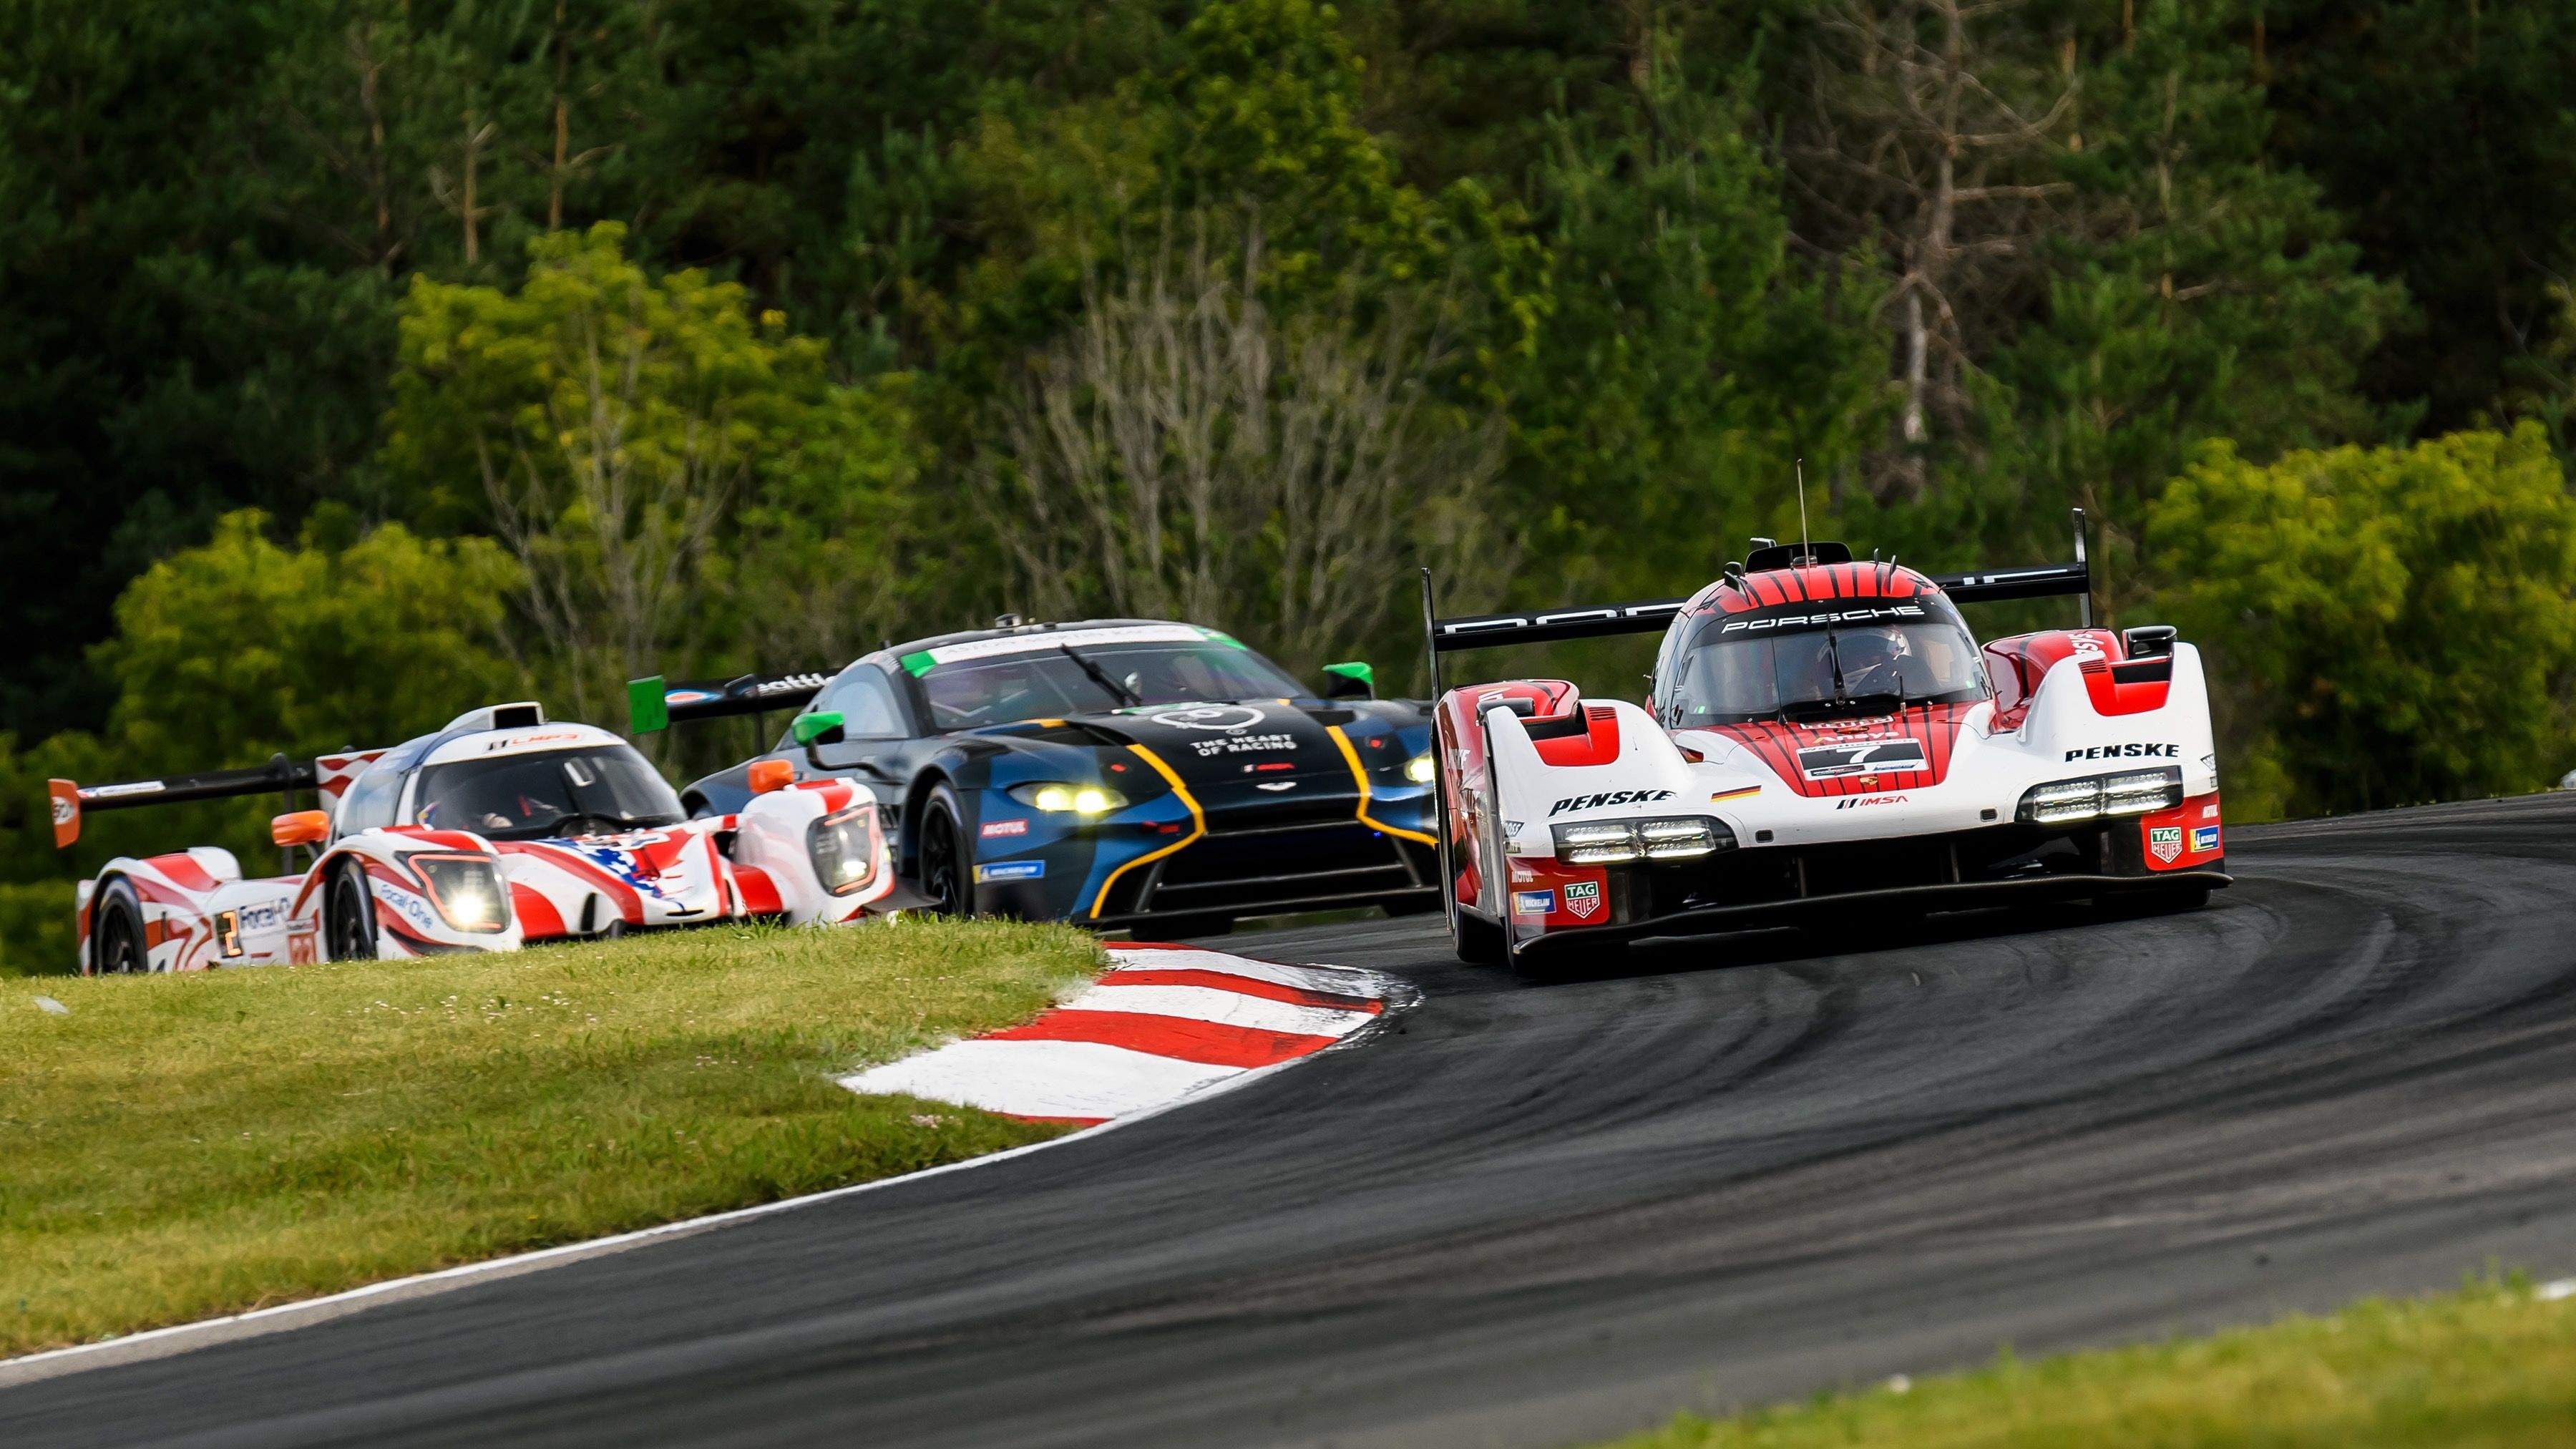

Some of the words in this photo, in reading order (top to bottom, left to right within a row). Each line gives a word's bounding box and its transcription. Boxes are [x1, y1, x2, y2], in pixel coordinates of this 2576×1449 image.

[1721, 605, 1925, 634] PORSCHE
[1189, 738, 1228, 748] THE
[1232, 734, 1292, 744] HEART
[1813, 731, 1901, 744] Ansys
[1198, 746, 1222, 756] OF
[1227, 741, 1298, 752] RACING
[1836, 745, 1881, 763] 7
[2065, 743, 2180, 762] PENSKE
[1548, 790, 1676, 817] PENSKE
[1859, 796, 1908, 806] IMSA
[2154, 829, 2180, 841] TAG
[2153, 843, 2181, 861] HEUER
[1511, 870, 1533, 883] MOTUL
[1567, 884, 1595, 897] TAG
[1524, 898, 1551, 907] MICHELIN
[1568, 897, 1598, 915] HEUER
